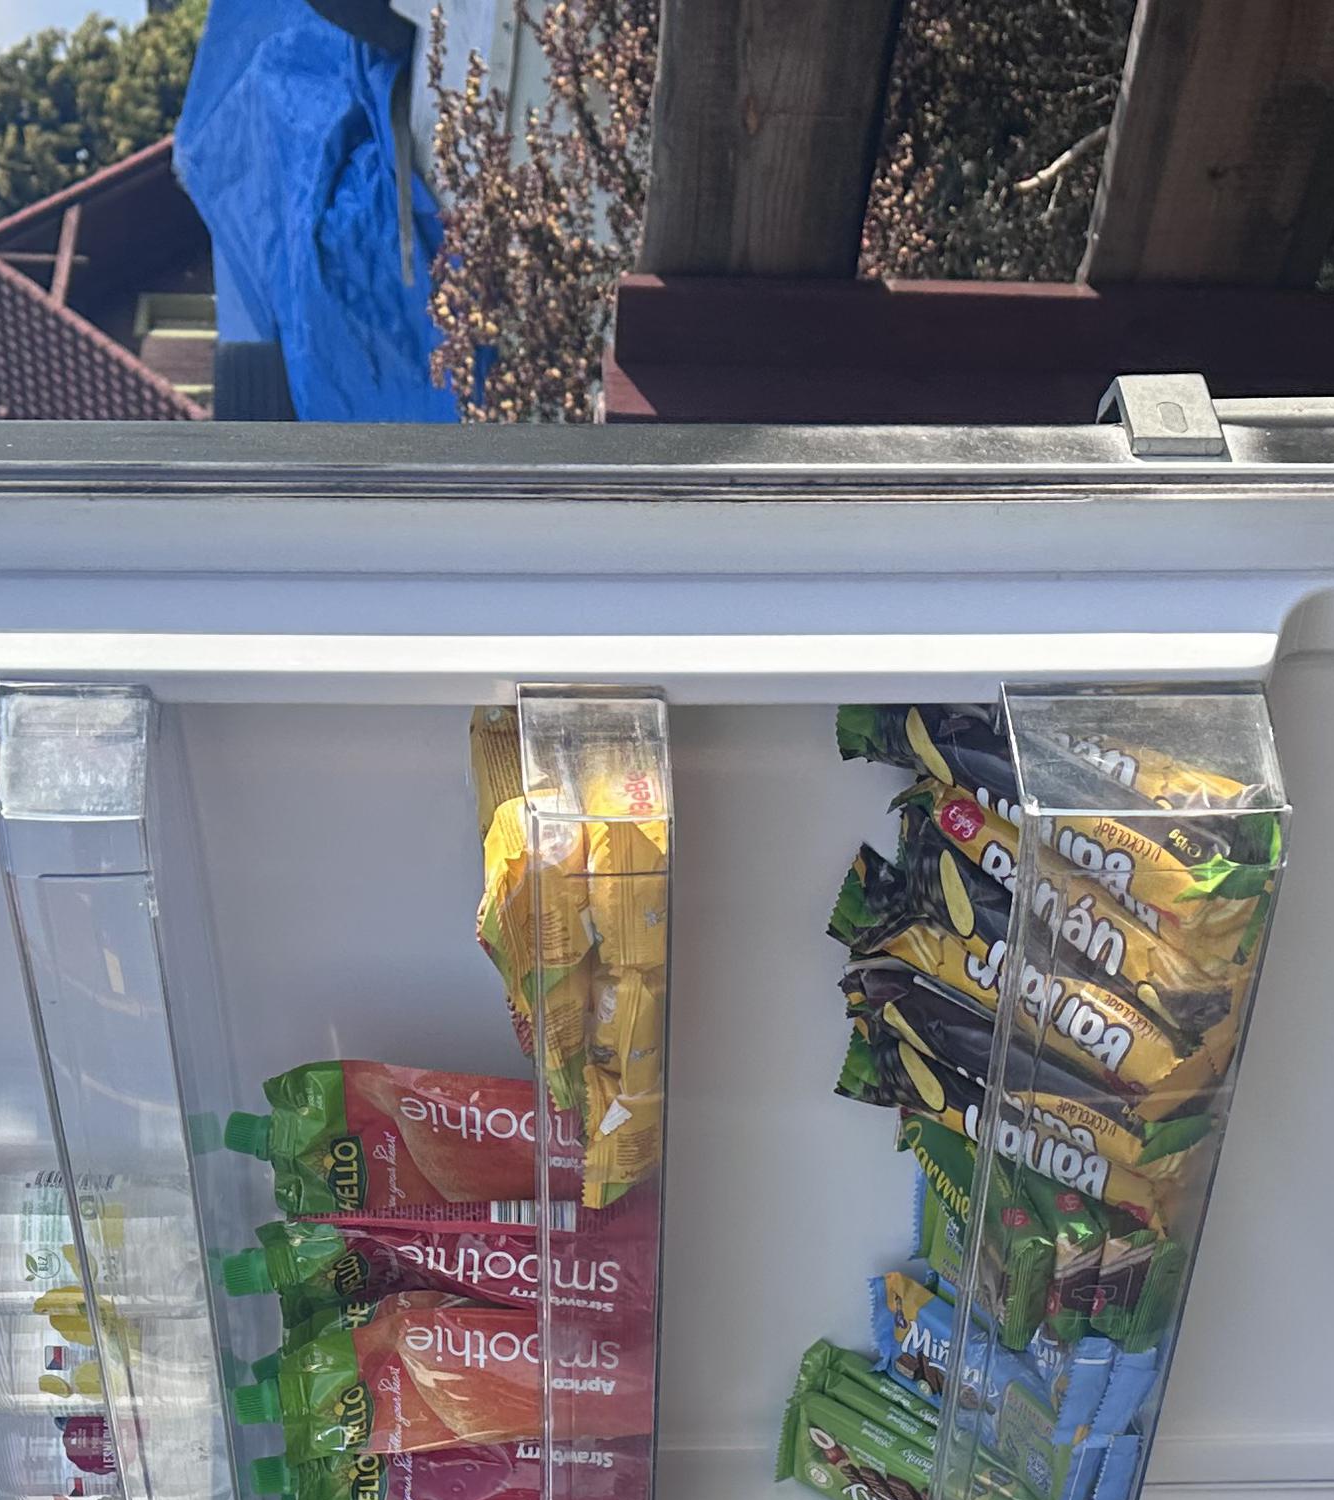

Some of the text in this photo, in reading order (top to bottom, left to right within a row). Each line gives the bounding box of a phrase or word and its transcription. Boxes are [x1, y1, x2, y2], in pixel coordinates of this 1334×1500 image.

[331, 1140, 360, 1211] HELLO
[372, 1131, 406, 1199] your heart
[37, 1256, 49, 1272] BEZ
[378, 1365, 404, 1398] heart
[342, 1385, 368, 1443] HELLO
[390, 1398, 410, 1422] your
